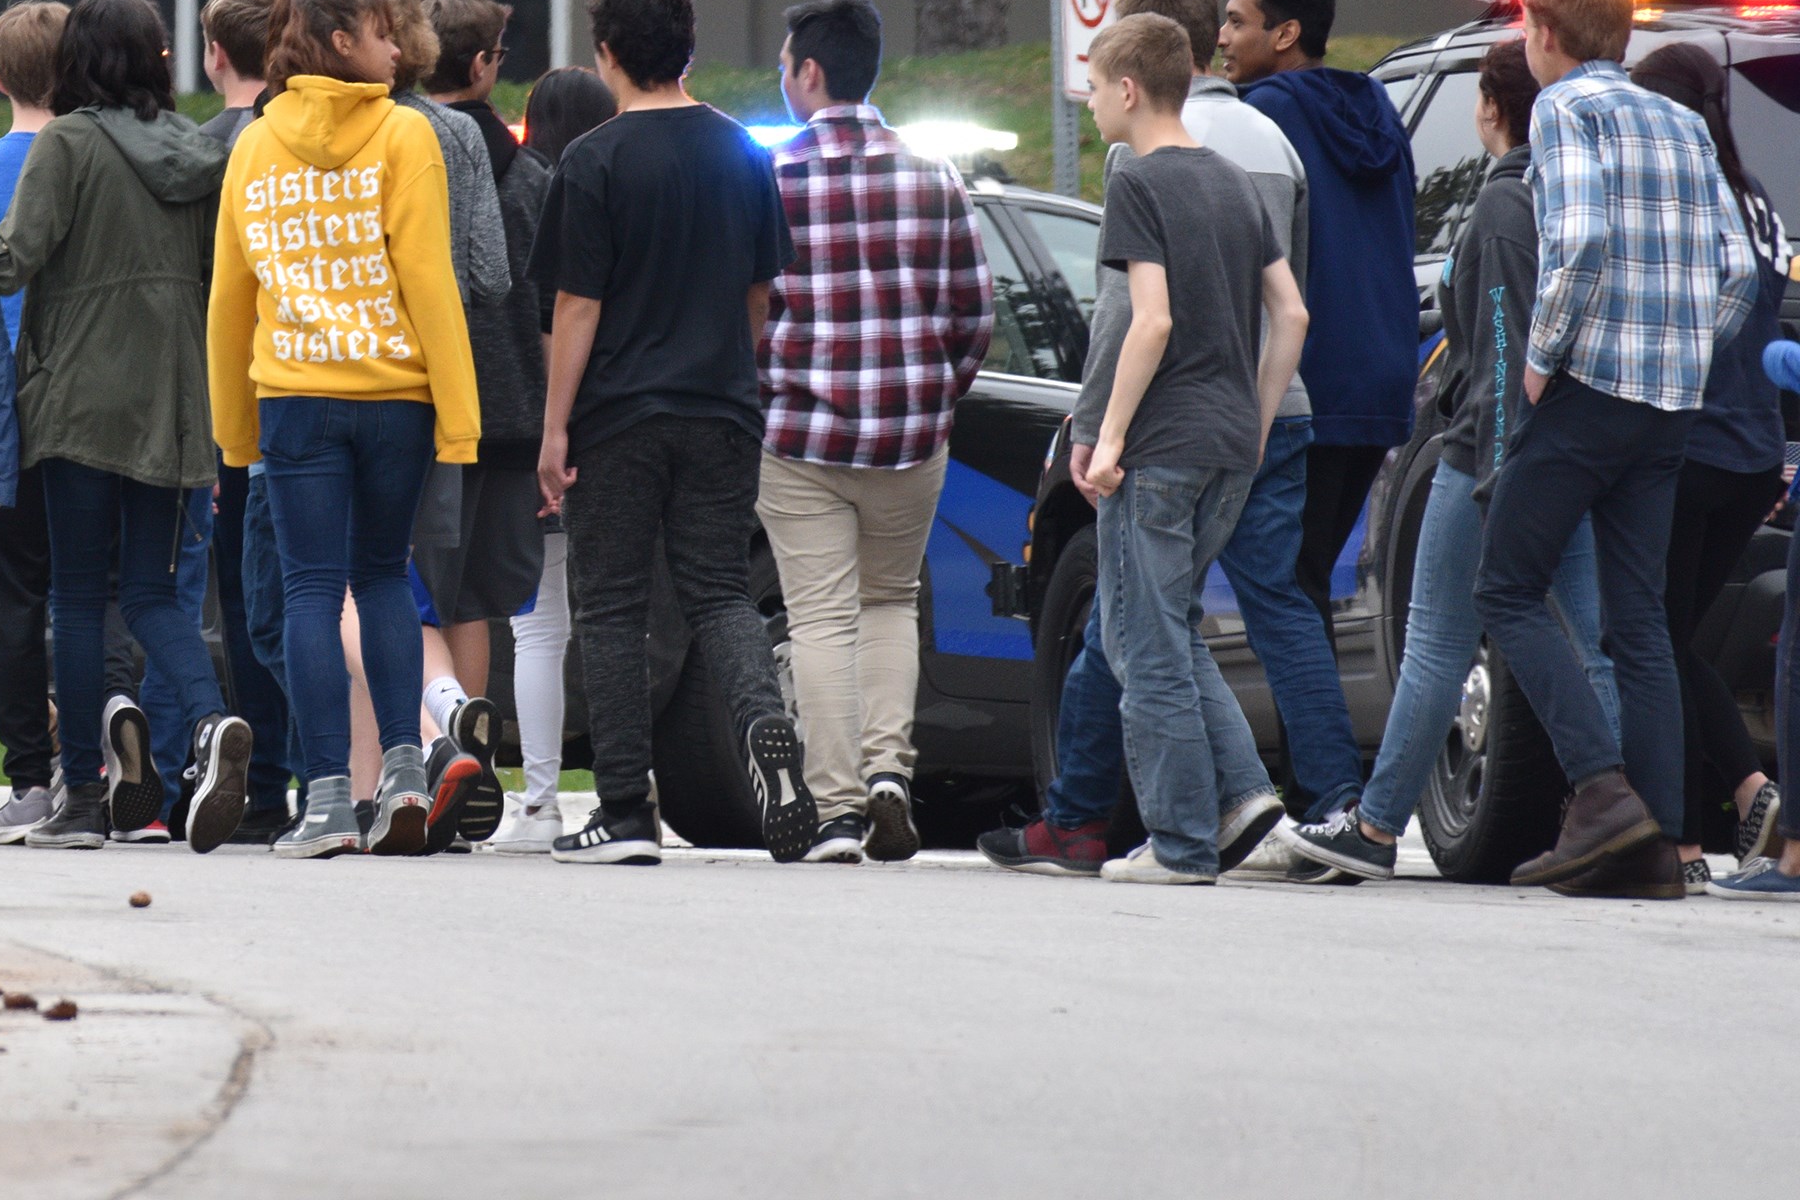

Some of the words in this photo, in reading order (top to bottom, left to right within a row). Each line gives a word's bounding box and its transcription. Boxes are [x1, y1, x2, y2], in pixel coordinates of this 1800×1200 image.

[244, 161, 383, 213] sisters
[245, 205, 384, 253] sisters
[255, 248, 389, 293] sisters
[1488, 286, 1509, 438] WASHINGTON
